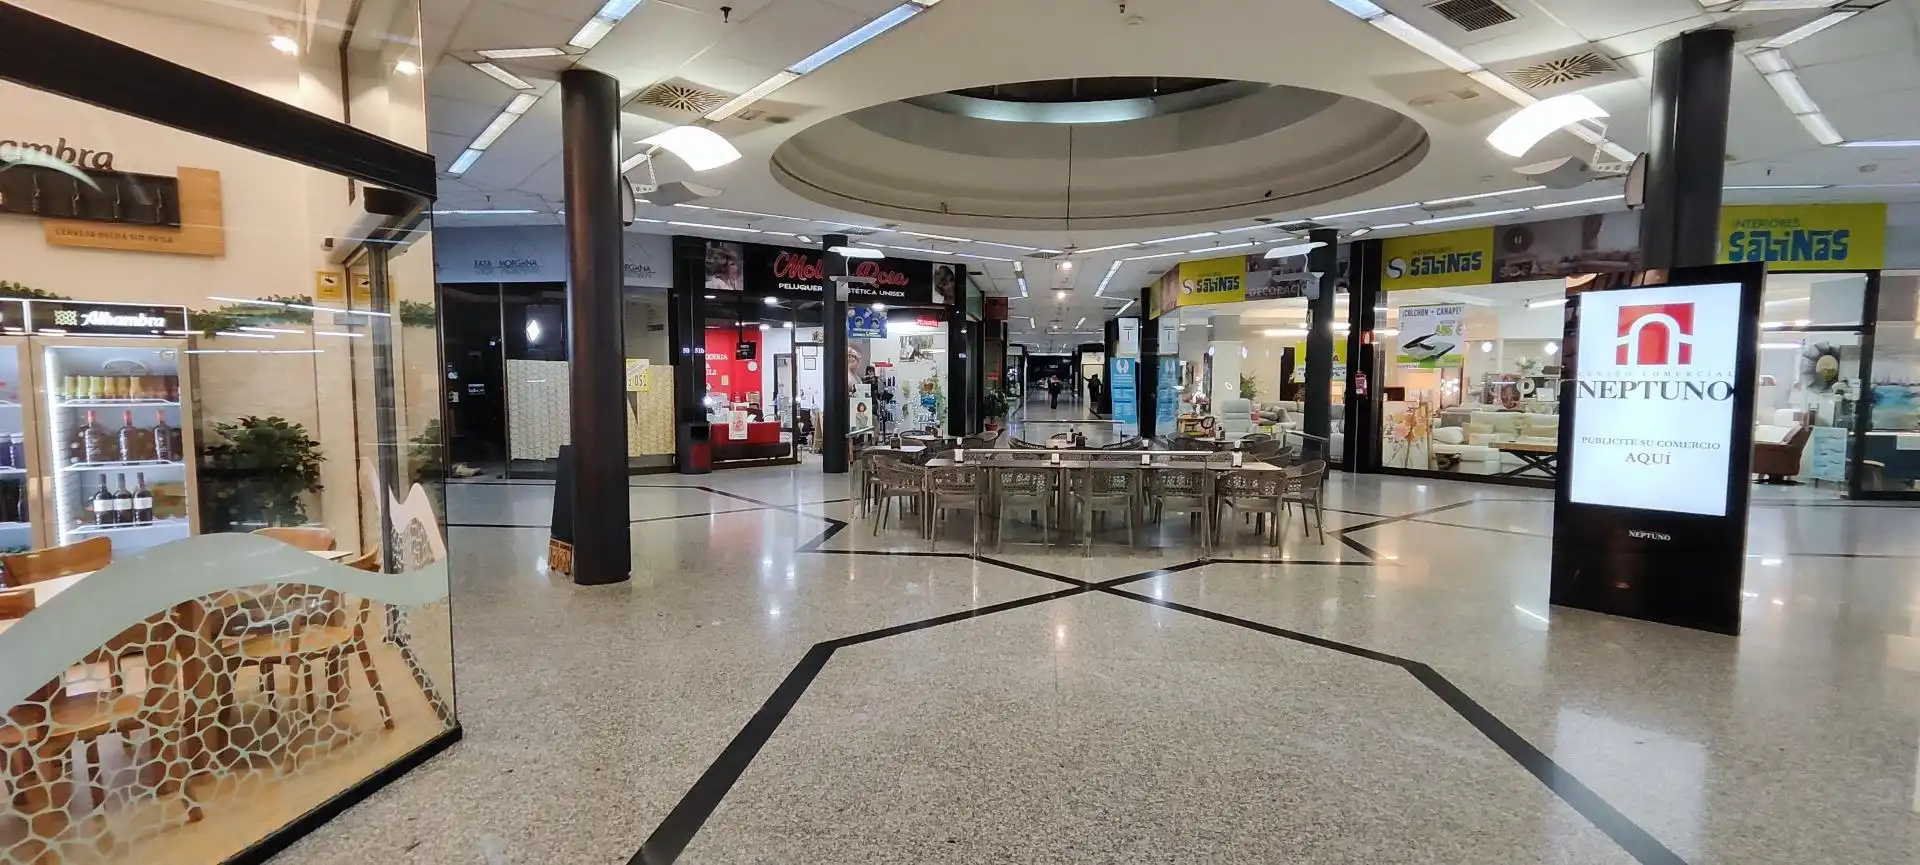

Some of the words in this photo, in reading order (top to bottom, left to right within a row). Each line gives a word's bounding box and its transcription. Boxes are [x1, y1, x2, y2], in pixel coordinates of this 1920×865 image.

[1734, 218, 1800, 228] INTERIORES
[624, 263, 652, 273] RGANA
[778, 282, 823, 292] PELUQUER
[847, 287, 877, 296] STÉTICA
[80, 310, 166, 327] Alhambra
[1576, 380, 1735, 401] NEPTUNO
[1581, 436, 1638, 446] PUBLICITE
[1640, 438, 1655, 447] SU
[1656, 440, 1721, 450] COMERCIO
[1624, 452, 1671, 466] AQUÍ
[1627, 529, 1672, 541] NEPTUNO
